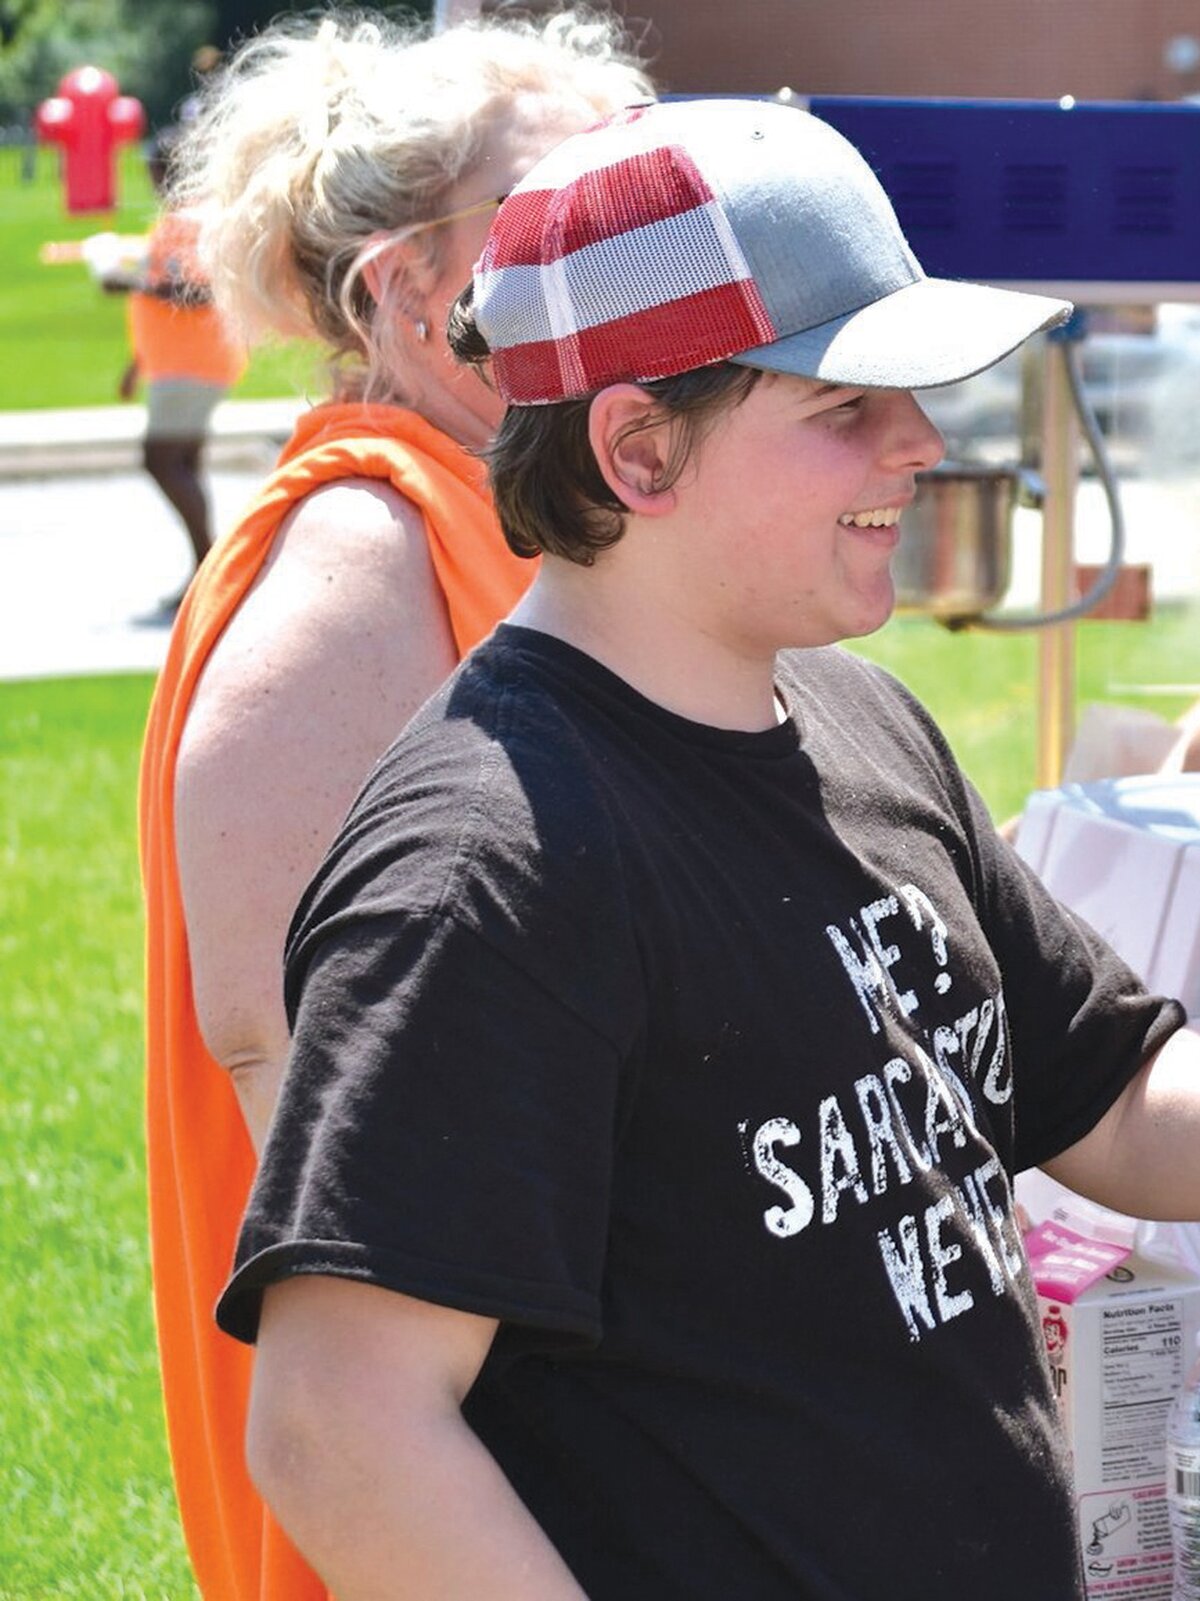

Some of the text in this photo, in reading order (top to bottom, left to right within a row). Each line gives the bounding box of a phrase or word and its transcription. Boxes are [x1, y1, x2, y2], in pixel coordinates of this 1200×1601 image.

[877, 1157, 1022, 1342] NEVE
[1103, 1303, 1175, 1319] Nutrition Facts
[1103, 1344, 1140, 1355] Calories
[1162, 1335, 1181, 1347] 110
